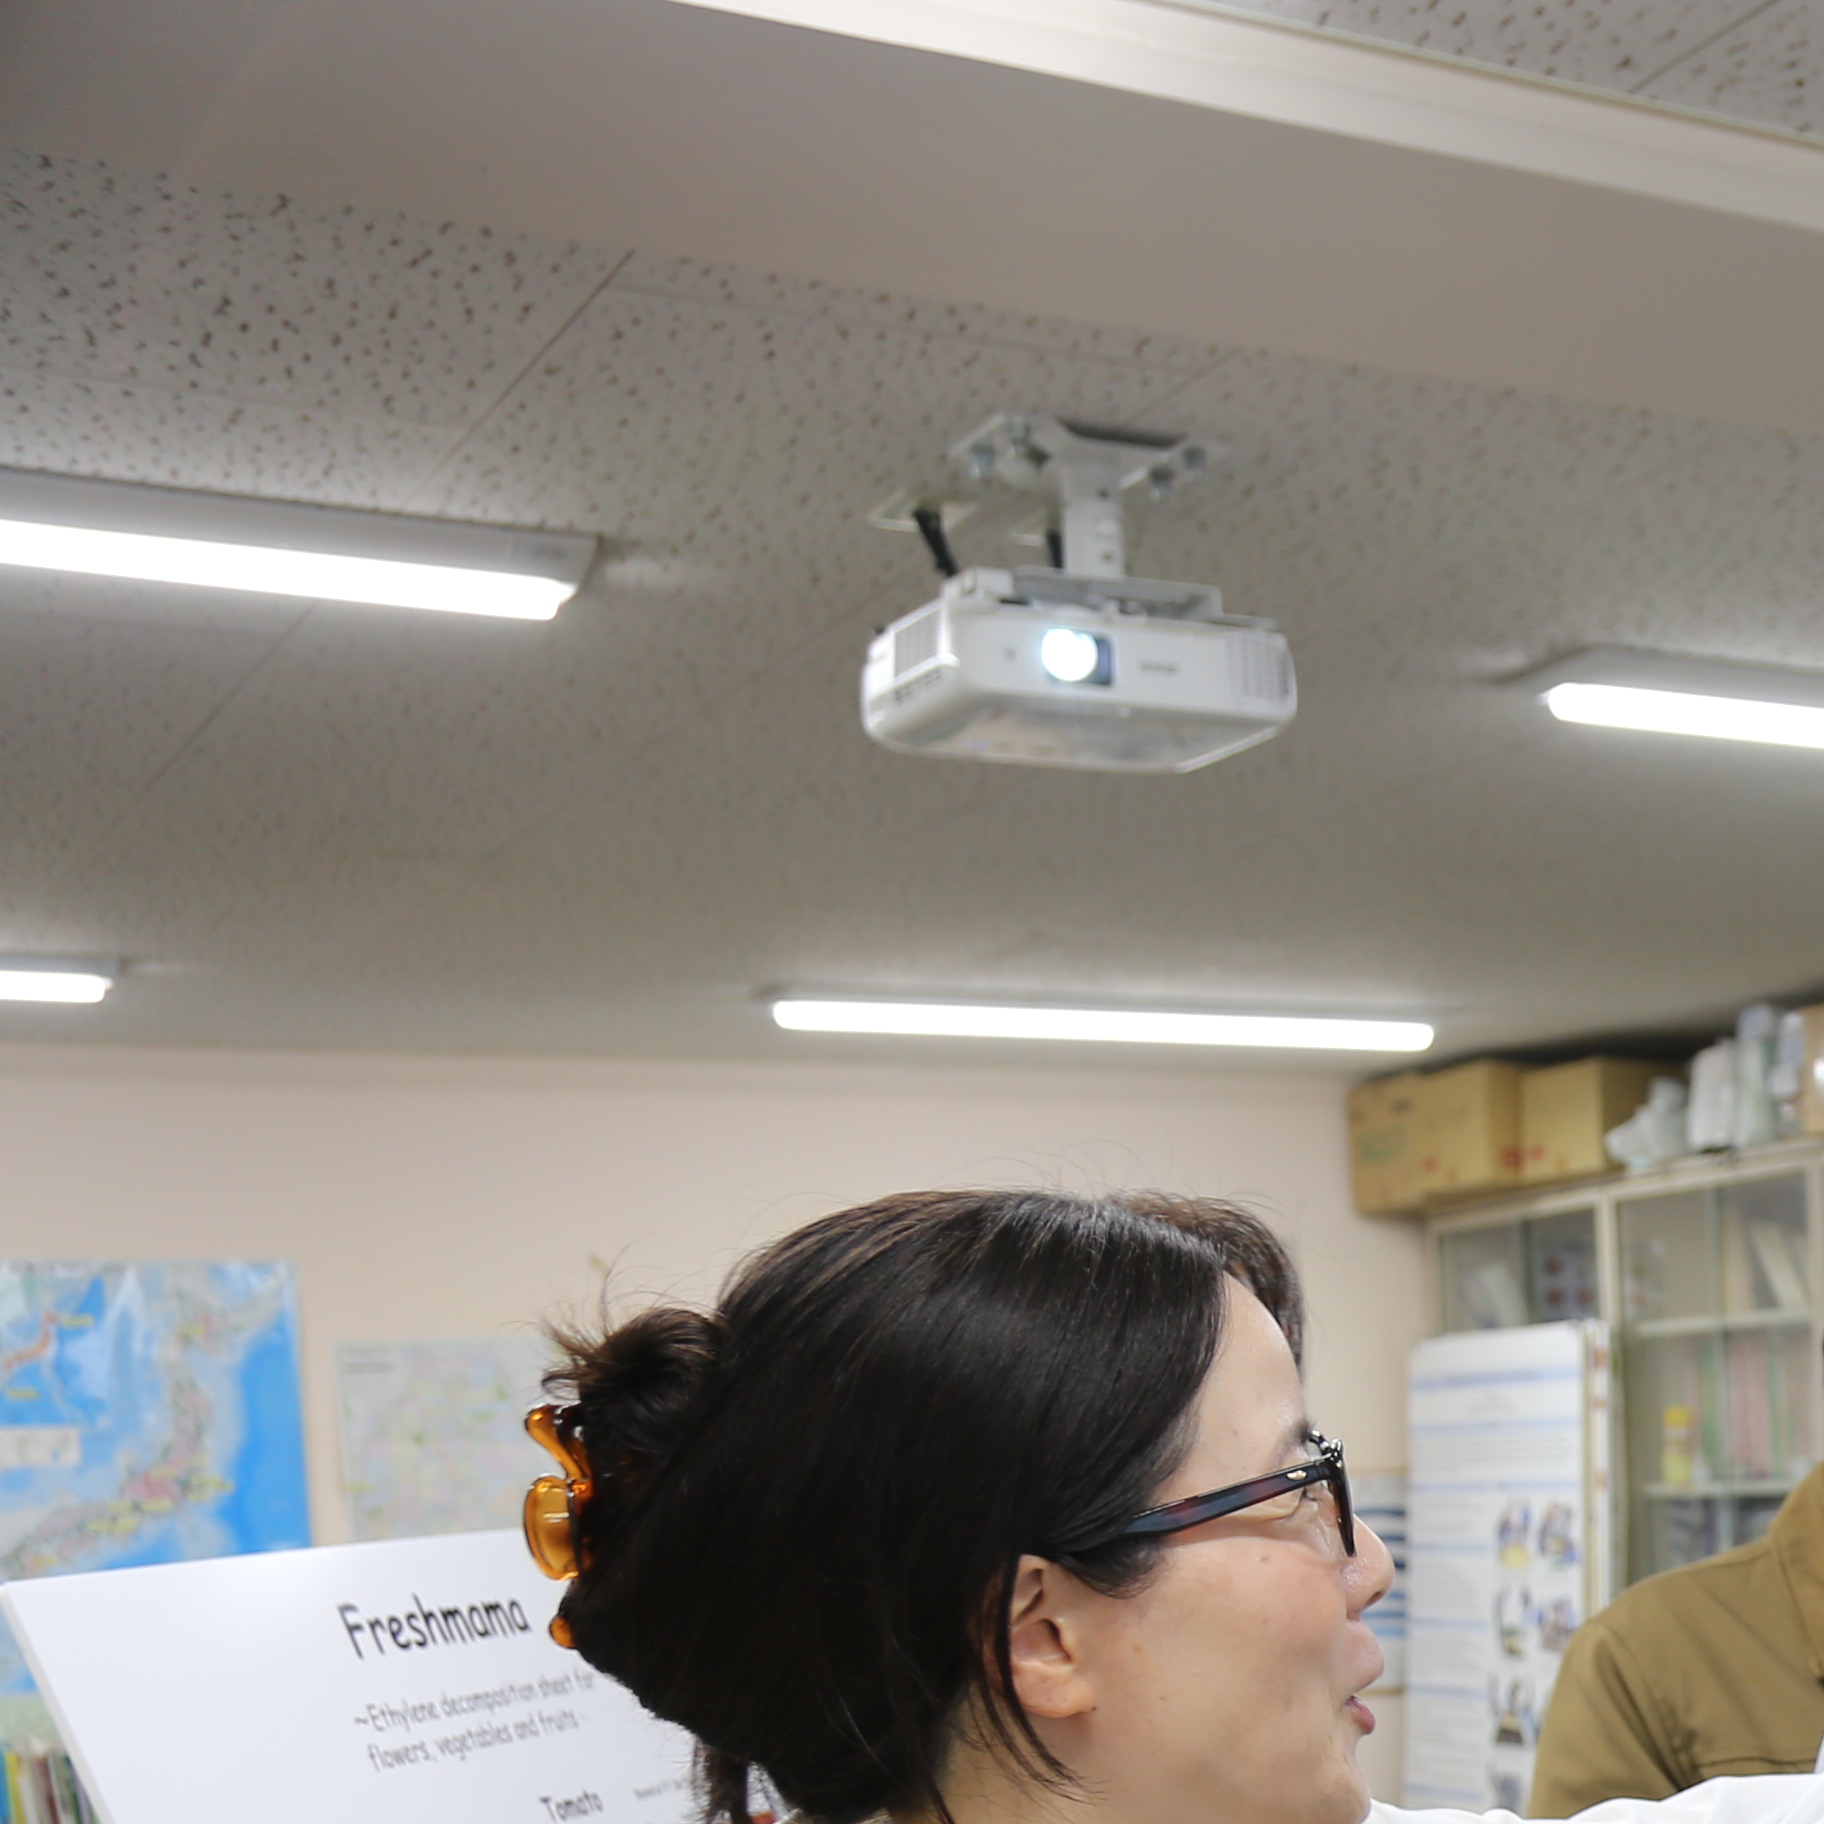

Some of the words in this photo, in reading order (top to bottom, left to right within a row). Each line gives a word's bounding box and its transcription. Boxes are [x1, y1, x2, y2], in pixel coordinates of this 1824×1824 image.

[337, 1592, 532, 1660] Freshmama
[435, 1720, 515, 1762] vegetables
[514, 1715, 542, 1742] and
[539, 1789, 604, 1823] Tomato
